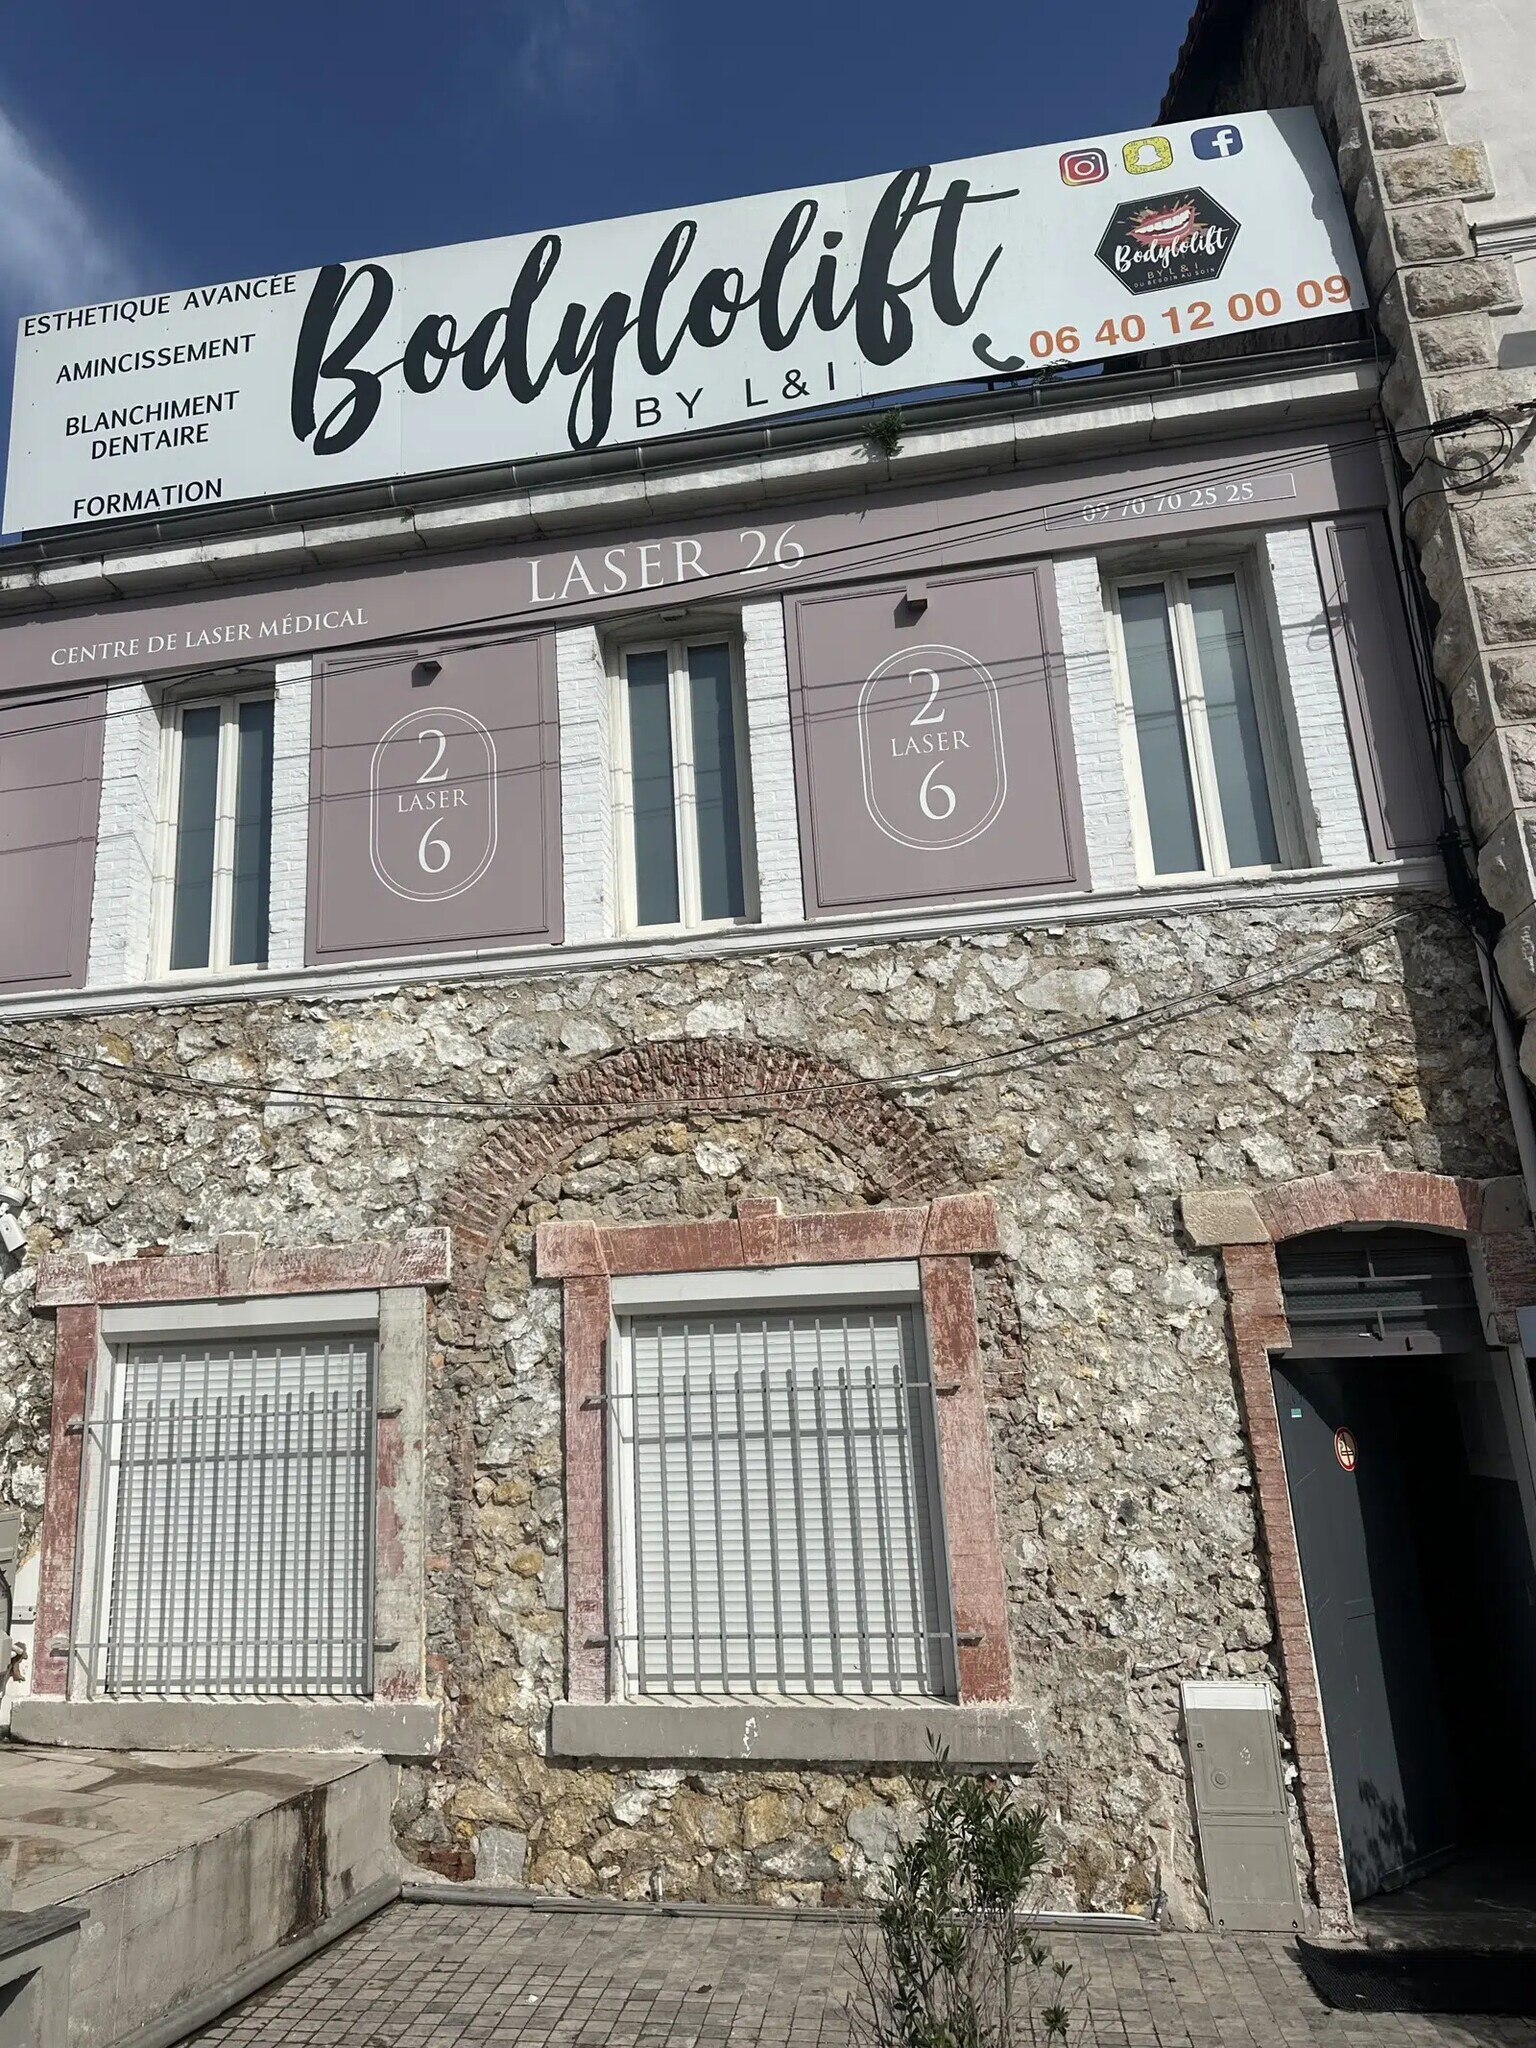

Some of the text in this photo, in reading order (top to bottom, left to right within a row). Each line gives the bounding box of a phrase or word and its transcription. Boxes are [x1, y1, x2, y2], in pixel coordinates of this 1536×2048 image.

[1114, 225, 1230, 273] Bodylolift
[24, 274, 297, 337] ESTHETIQUE AVANCÉE
[291, 165, 1020, 452] Bodylolift
[1029, 275, 1351, 358] 06 40 12 00 09
[55, 334, 256, 384] AMINCISSEMENT
[65, 391, 240, 436] BLANCHIMENT
[635, 387, 704, 428] BY
[91, 423, 209, 460] DENTAIRE
[73, 478, 223, 519] FORMATION
[1153, 493, 1181, 512] 70
[1189, 487, 1217, 507] 25
[1225, 482, 1254, 502] 25
[528, 524, 805, 603] LASER 26
[51, 608, 369, 666] CENTRE DE LASER MÉDICAL
[908, 667, 946, 726] 2
[416, 729, 449, 784] 2
[891, 730, 972, 757] LASER
[397, 788, 469, 813] LASER
[919, 760, 956, 820] 6
[418, 816, 451, 873] 6
